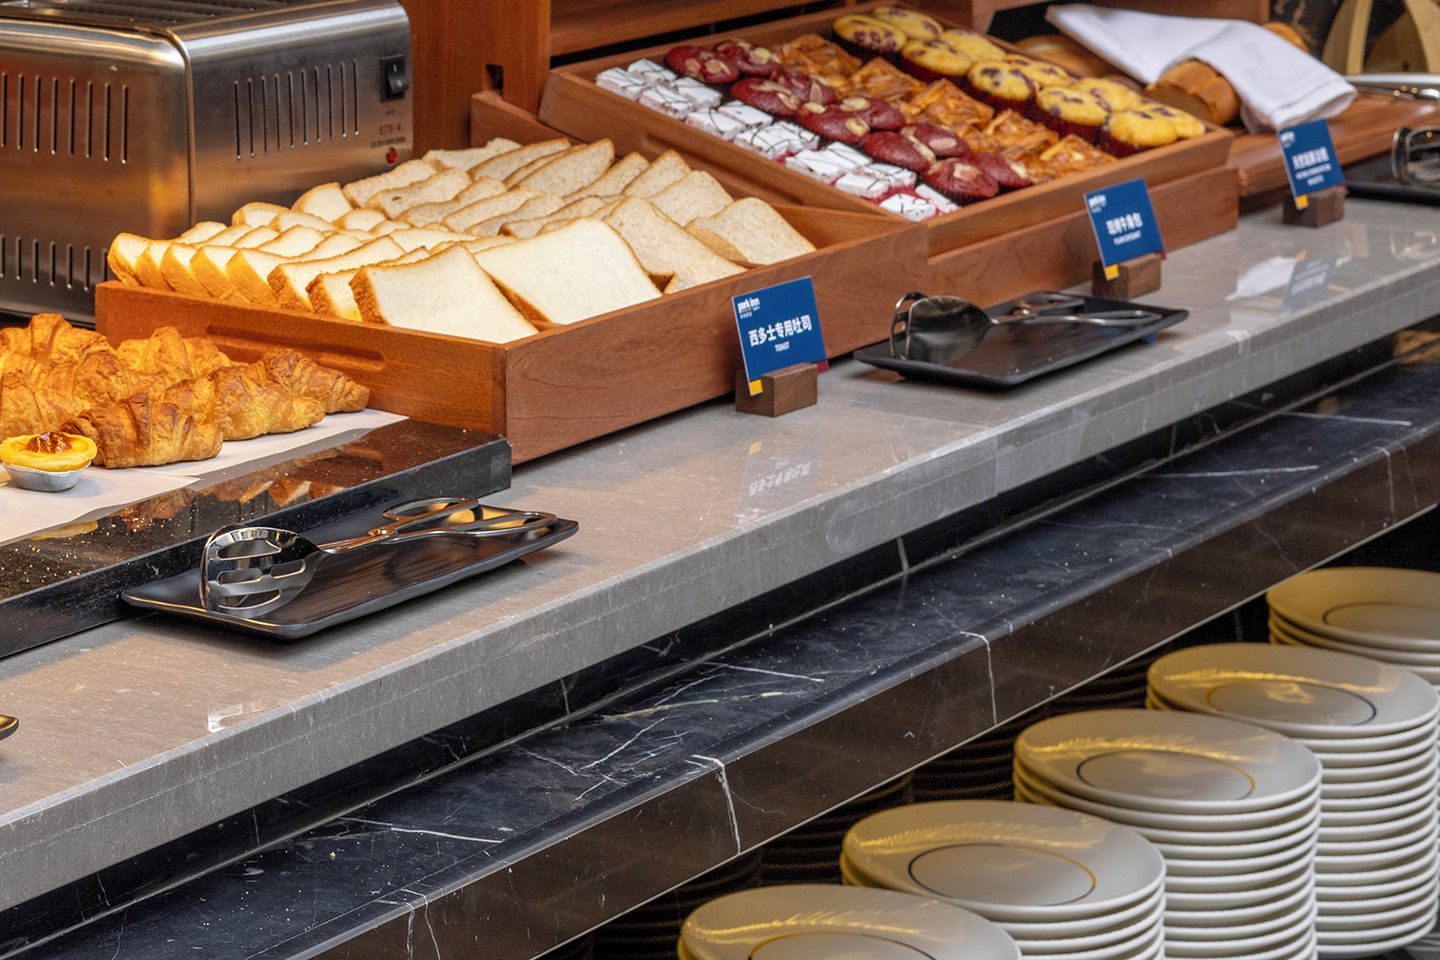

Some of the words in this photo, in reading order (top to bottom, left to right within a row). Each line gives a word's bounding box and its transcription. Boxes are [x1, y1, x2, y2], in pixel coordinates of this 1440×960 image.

[748, 315, 812, 347] 西多士专用吐司
